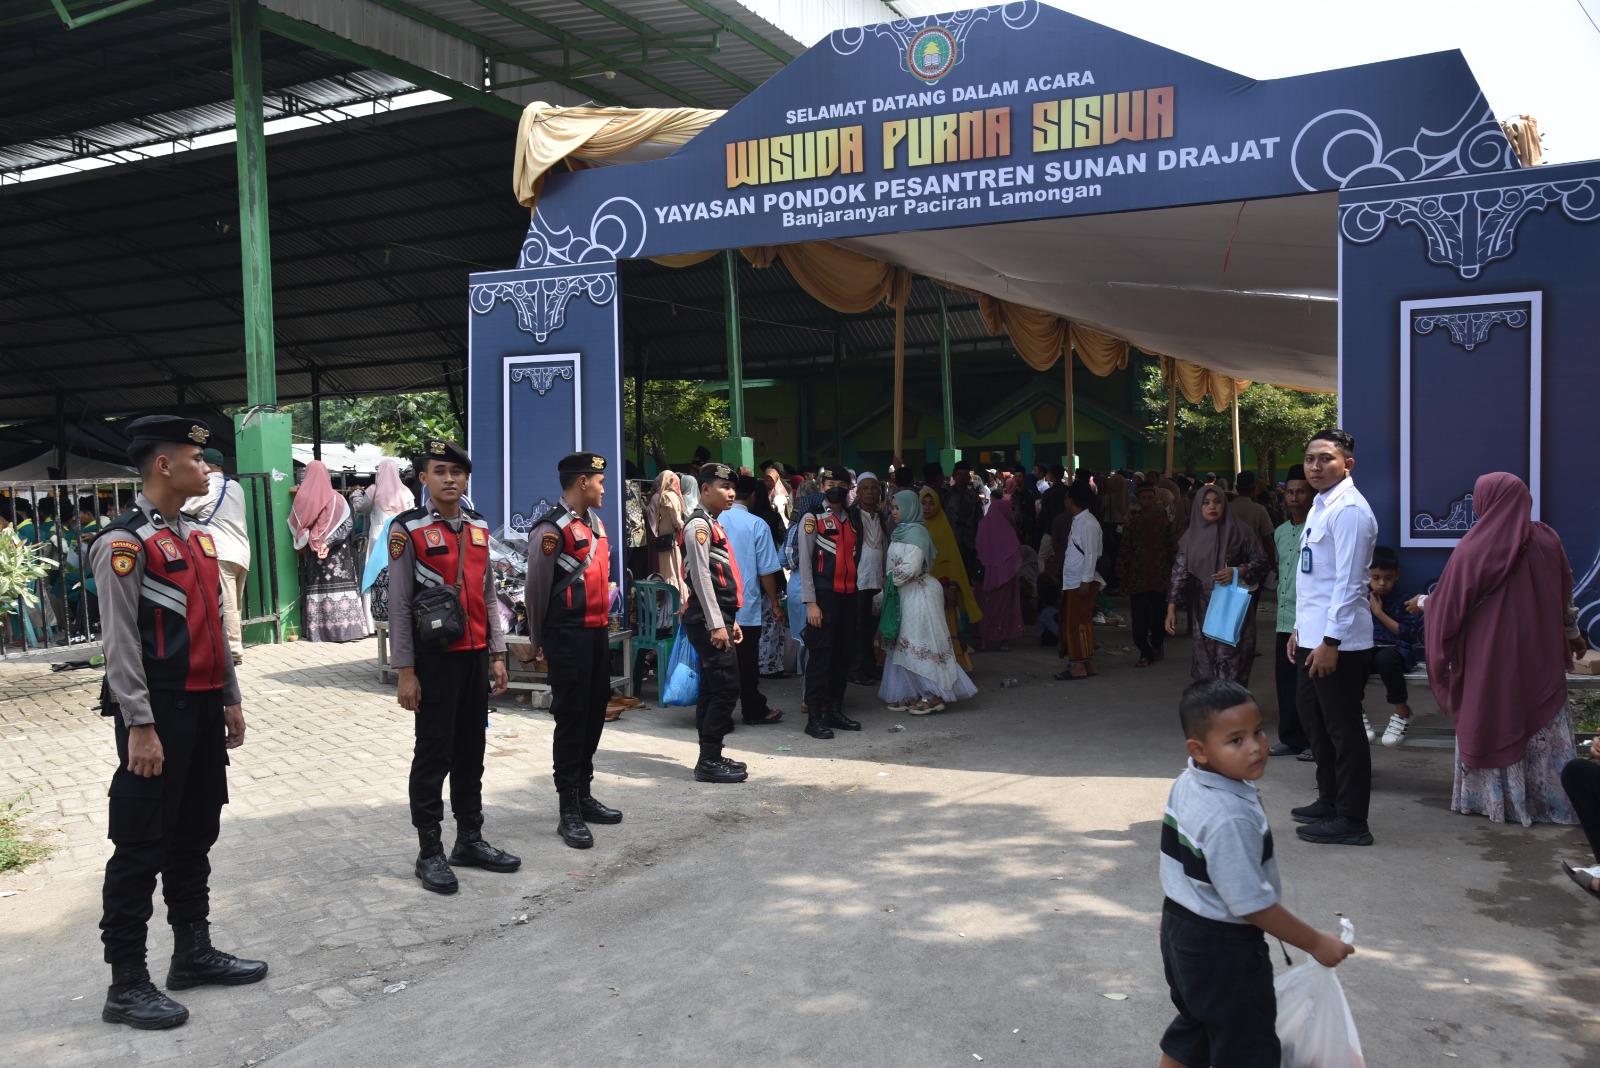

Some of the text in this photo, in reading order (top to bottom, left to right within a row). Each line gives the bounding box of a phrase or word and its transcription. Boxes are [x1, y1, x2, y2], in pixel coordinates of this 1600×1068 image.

[785, 70, 1095, 125] SELAMAT DATANG DALAM ACARA
[726, 86, 1174, 189] WISUDA PURNA SISWA
[654, 136, 1281, 225] YAYASAN PONDOK PESANTREN SUNAN DRAJAT
[782, 184, 1102, 228] Banjaranyar Paciran Lamongan
